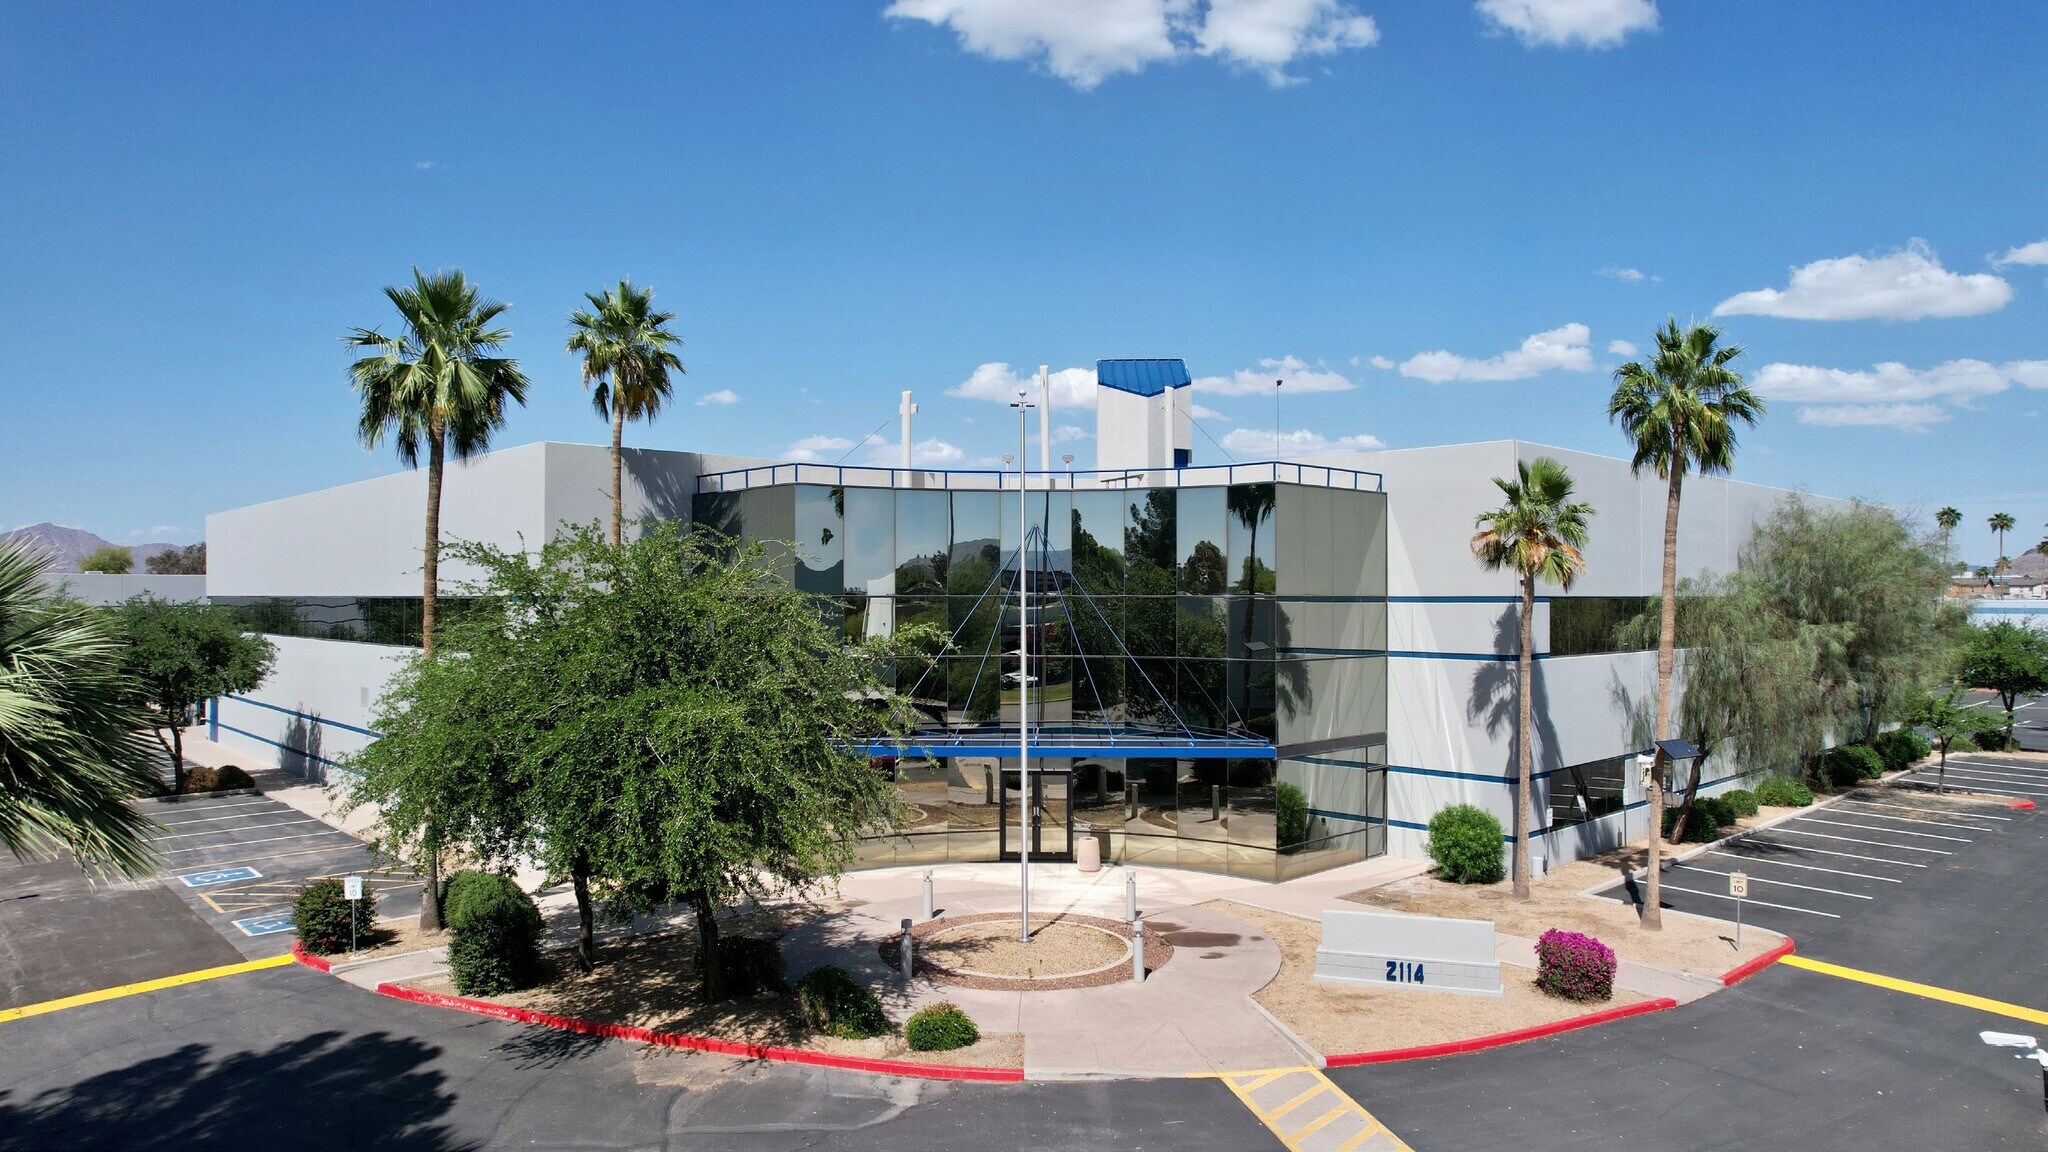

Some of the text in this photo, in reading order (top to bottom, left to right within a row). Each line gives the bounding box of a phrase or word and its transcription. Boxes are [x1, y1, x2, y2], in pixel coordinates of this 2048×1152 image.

[349, 889, 358, 897] 10
[1733, 885, 1744, 893] 10
[1386, 960, 1424, 984] 2114
